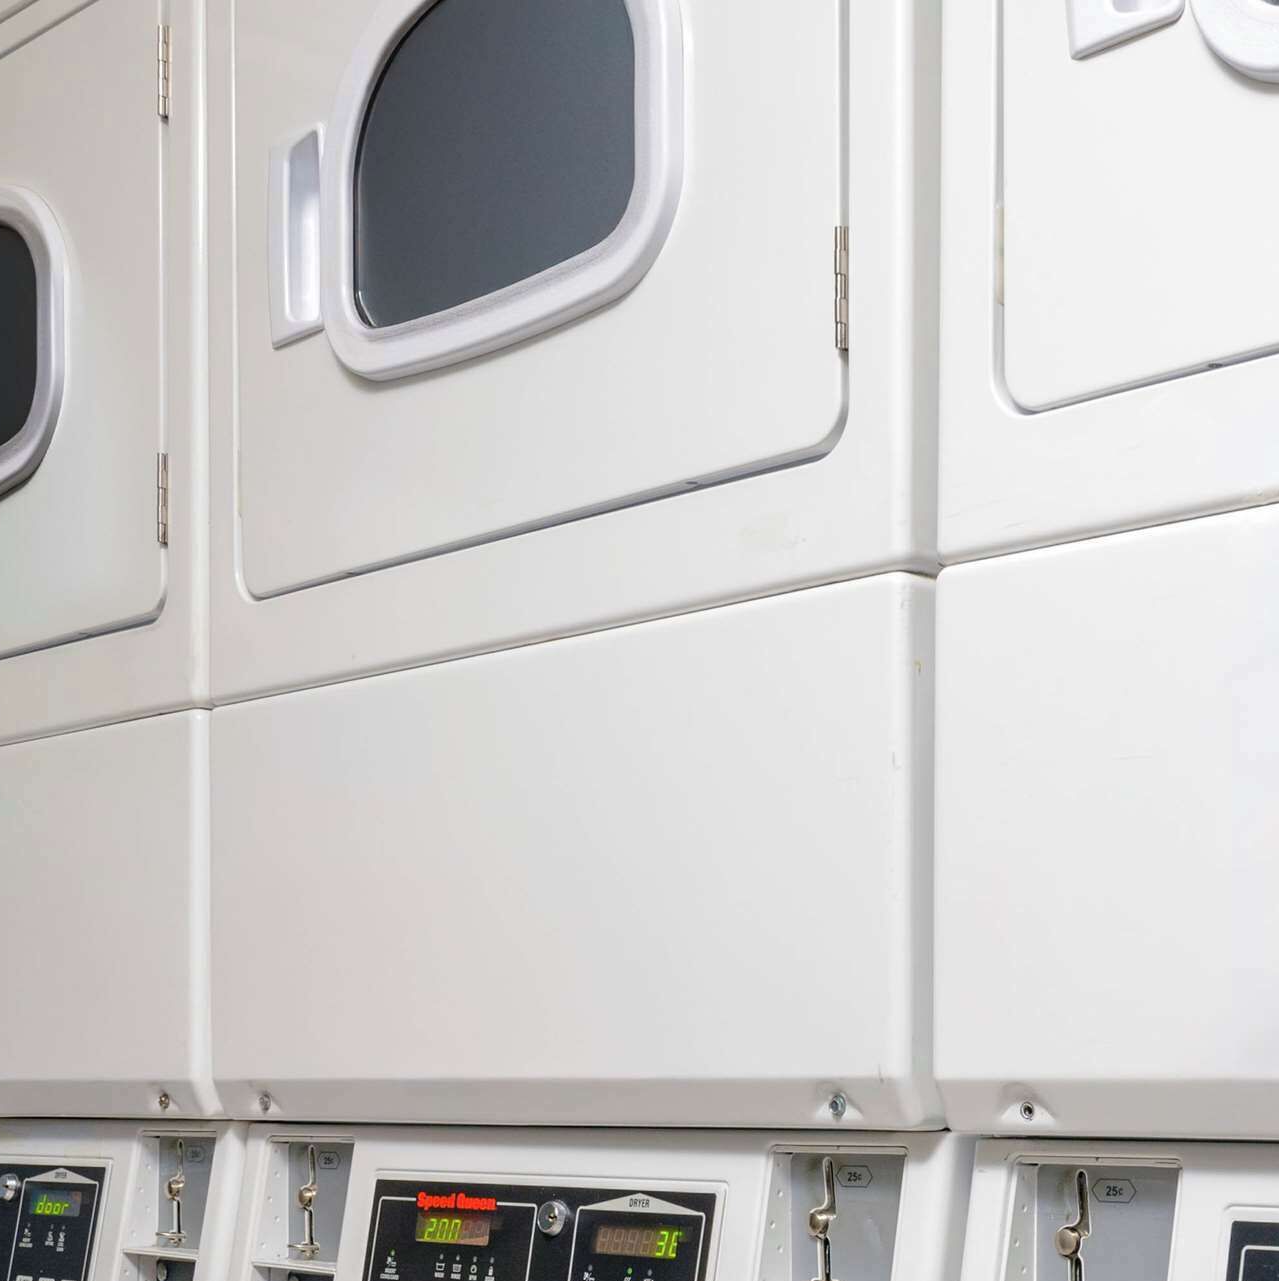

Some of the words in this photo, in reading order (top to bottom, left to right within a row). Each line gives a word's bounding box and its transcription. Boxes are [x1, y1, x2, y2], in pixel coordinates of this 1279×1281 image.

[1106, 1185, 1123, 1196] 25¢
[417, 1191, 456, 1210] Speed
[629, 1198, 650, 1208] DRYER
